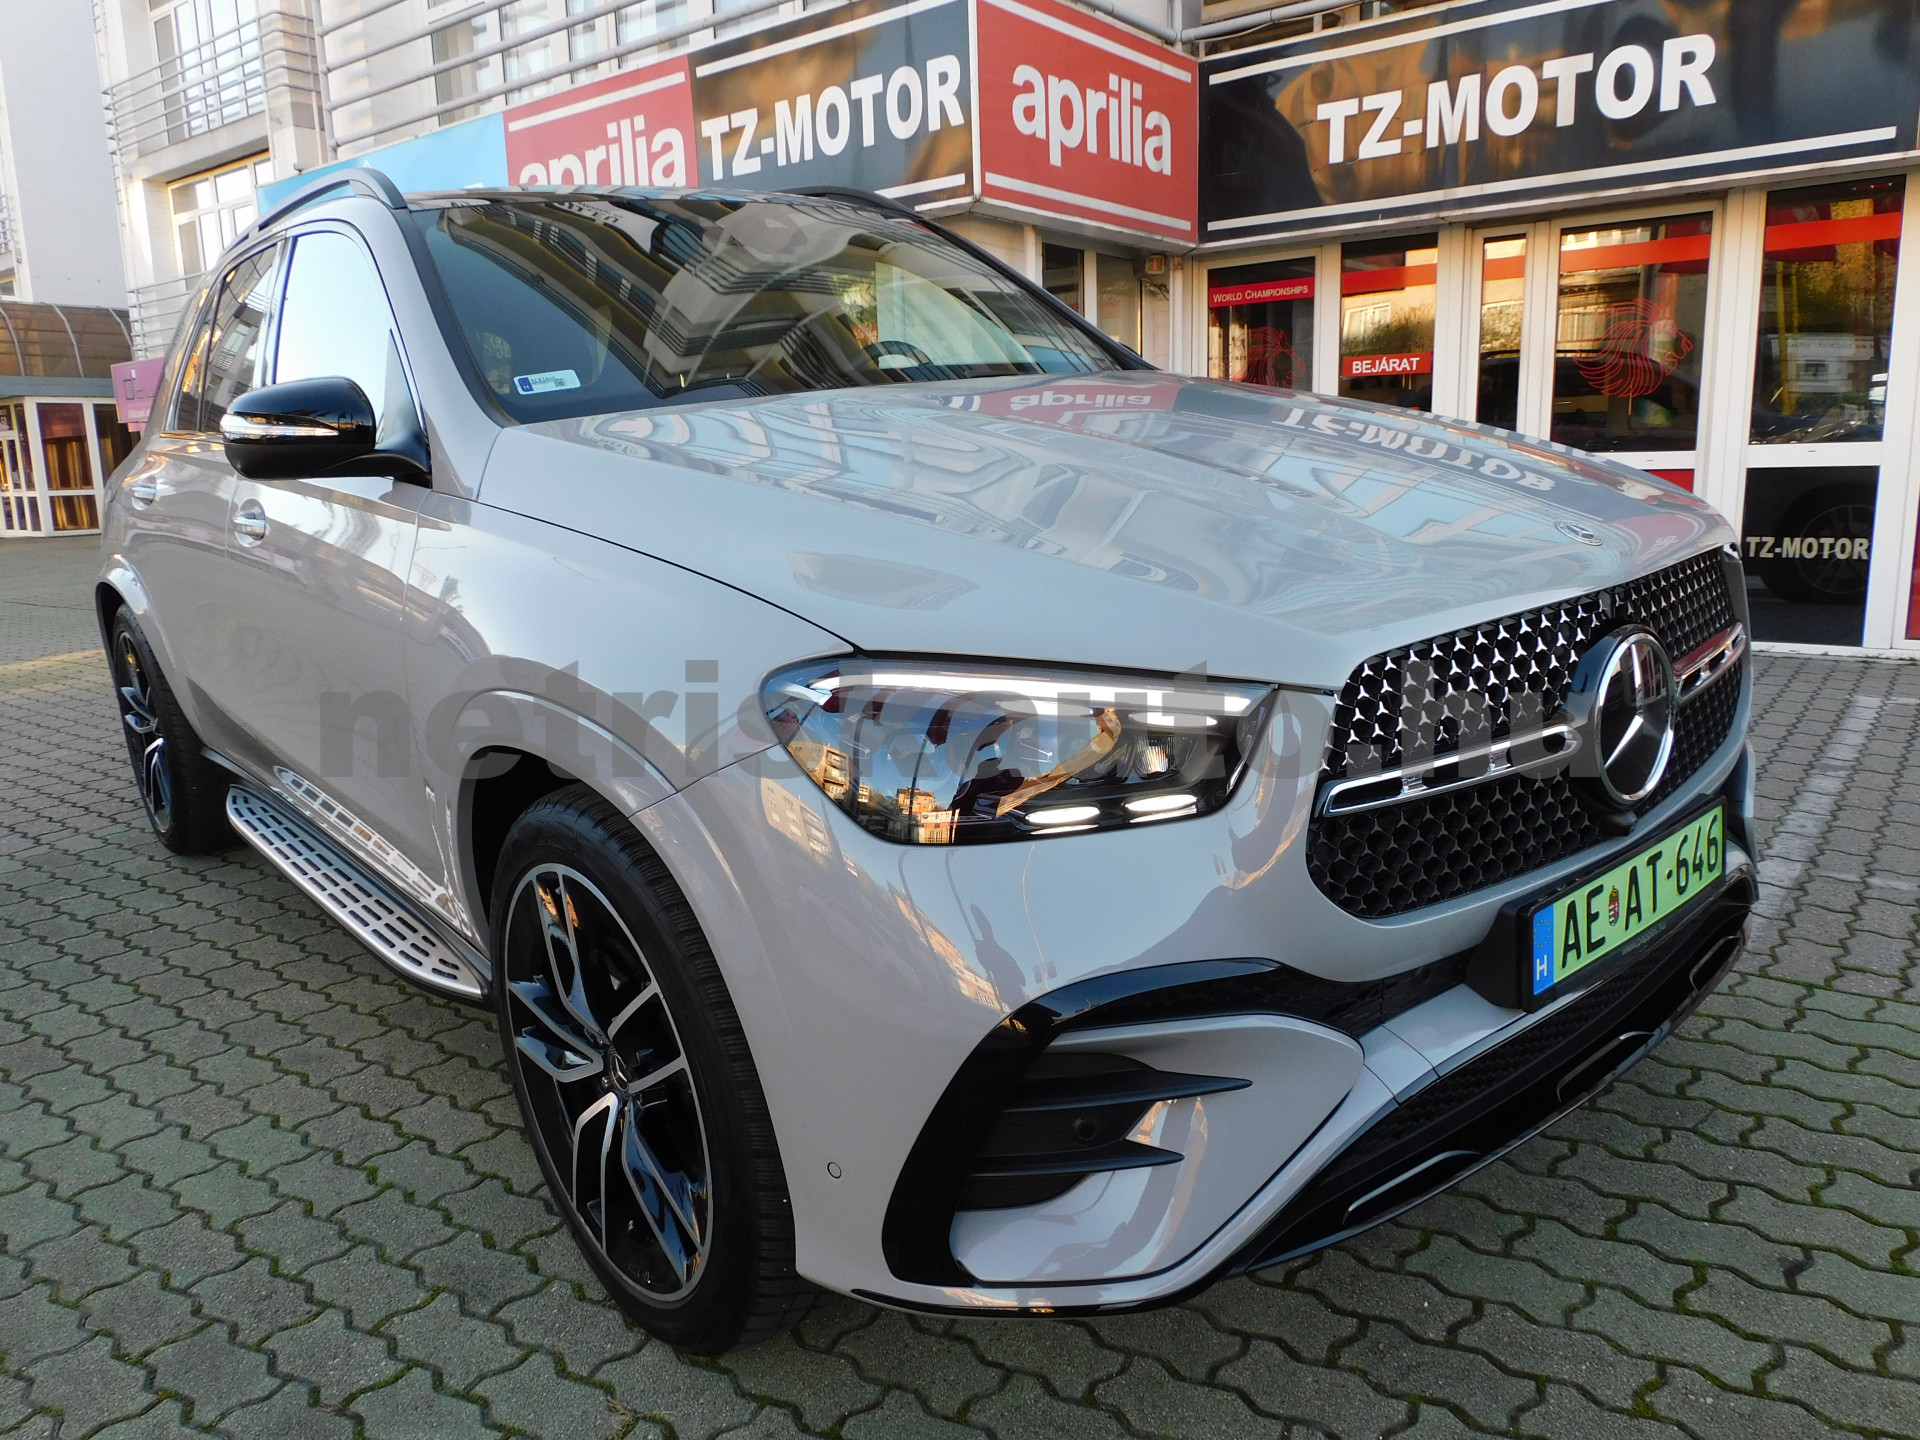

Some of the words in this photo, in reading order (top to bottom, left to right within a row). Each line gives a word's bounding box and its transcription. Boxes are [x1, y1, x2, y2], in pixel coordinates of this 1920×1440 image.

[701, 54, 964, 180] TZ-MOTOR
[1012, 64, 1172, 176] aprilia
[1316, 33, 1717, 164] TZ-MOTOR
[1352, 356, 1420, 374] BEJÁRAT
[1746, 537, 1869, 560] TZ-MOTOR
[1561, 884, 1606, 969] AE
[1624, 814, 1719, 931] AT-646
[1536, 954, 1548, 981] H
